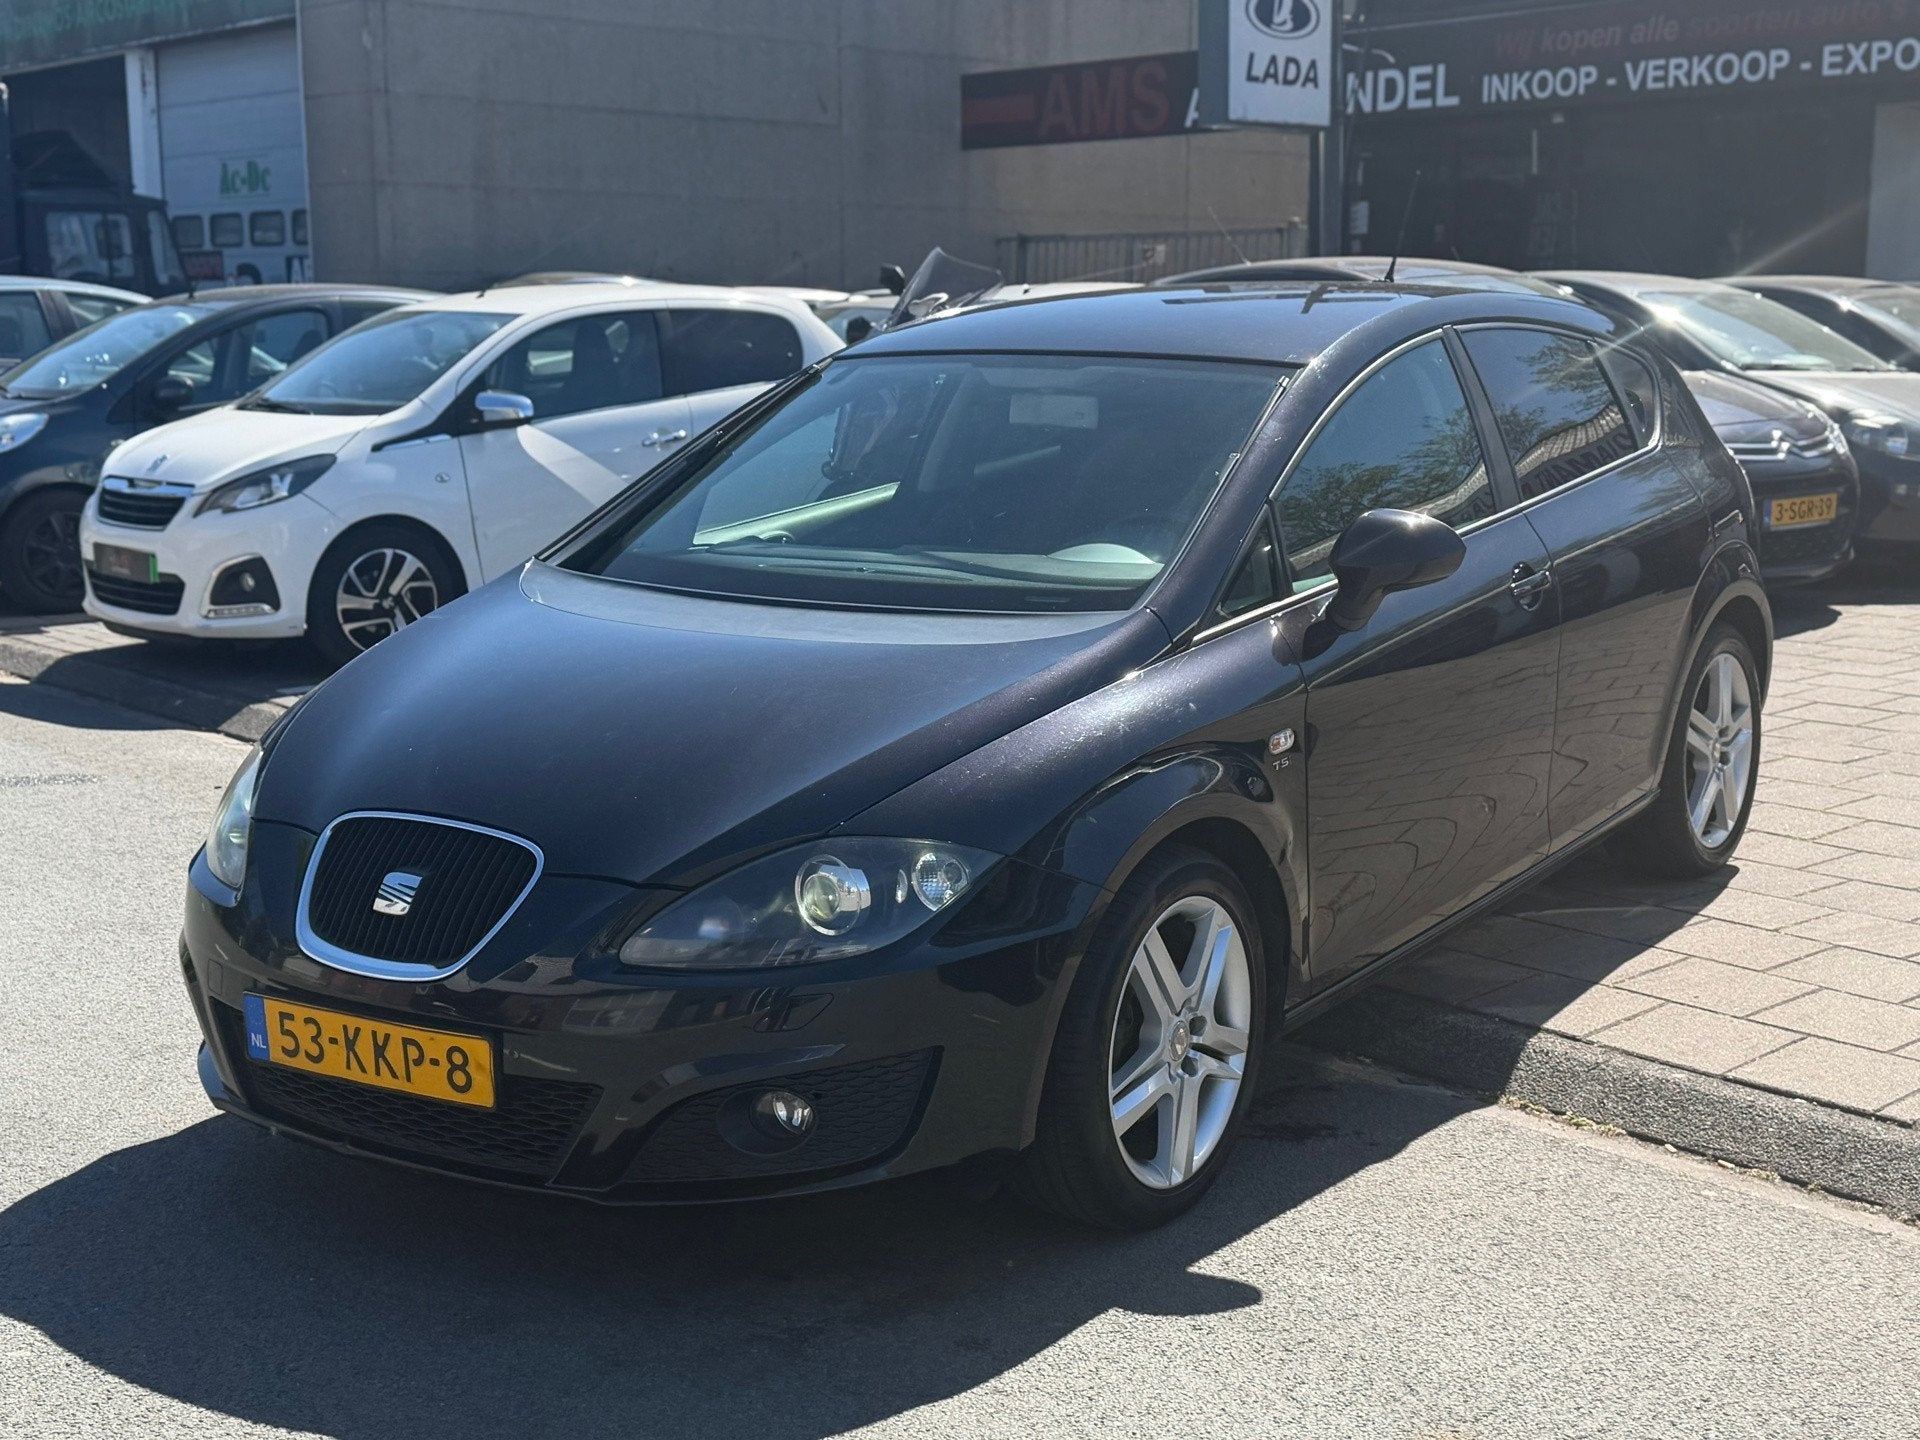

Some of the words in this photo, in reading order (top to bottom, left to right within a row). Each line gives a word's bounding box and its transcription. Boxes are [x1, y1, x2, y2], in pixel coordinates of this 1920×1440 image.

[1541, 25, 1622, 56] kopen
[1629, 14, 1681, 44] alle
[1038, 61, 1169, 138] AMS
[1482, 65, 1598, 103] INKOOP
[1625, 47, 1790, 92] VERKOOP
[1821, 36, 1920, 76] EXPO
[1245, 52, 1319, 89] LADA
[1775, 498, 1833, 522] 3-SGR-39
[251, 1033, 267, 1049] NL
[278, 1011, 473, 1094] 53-KKP-8
